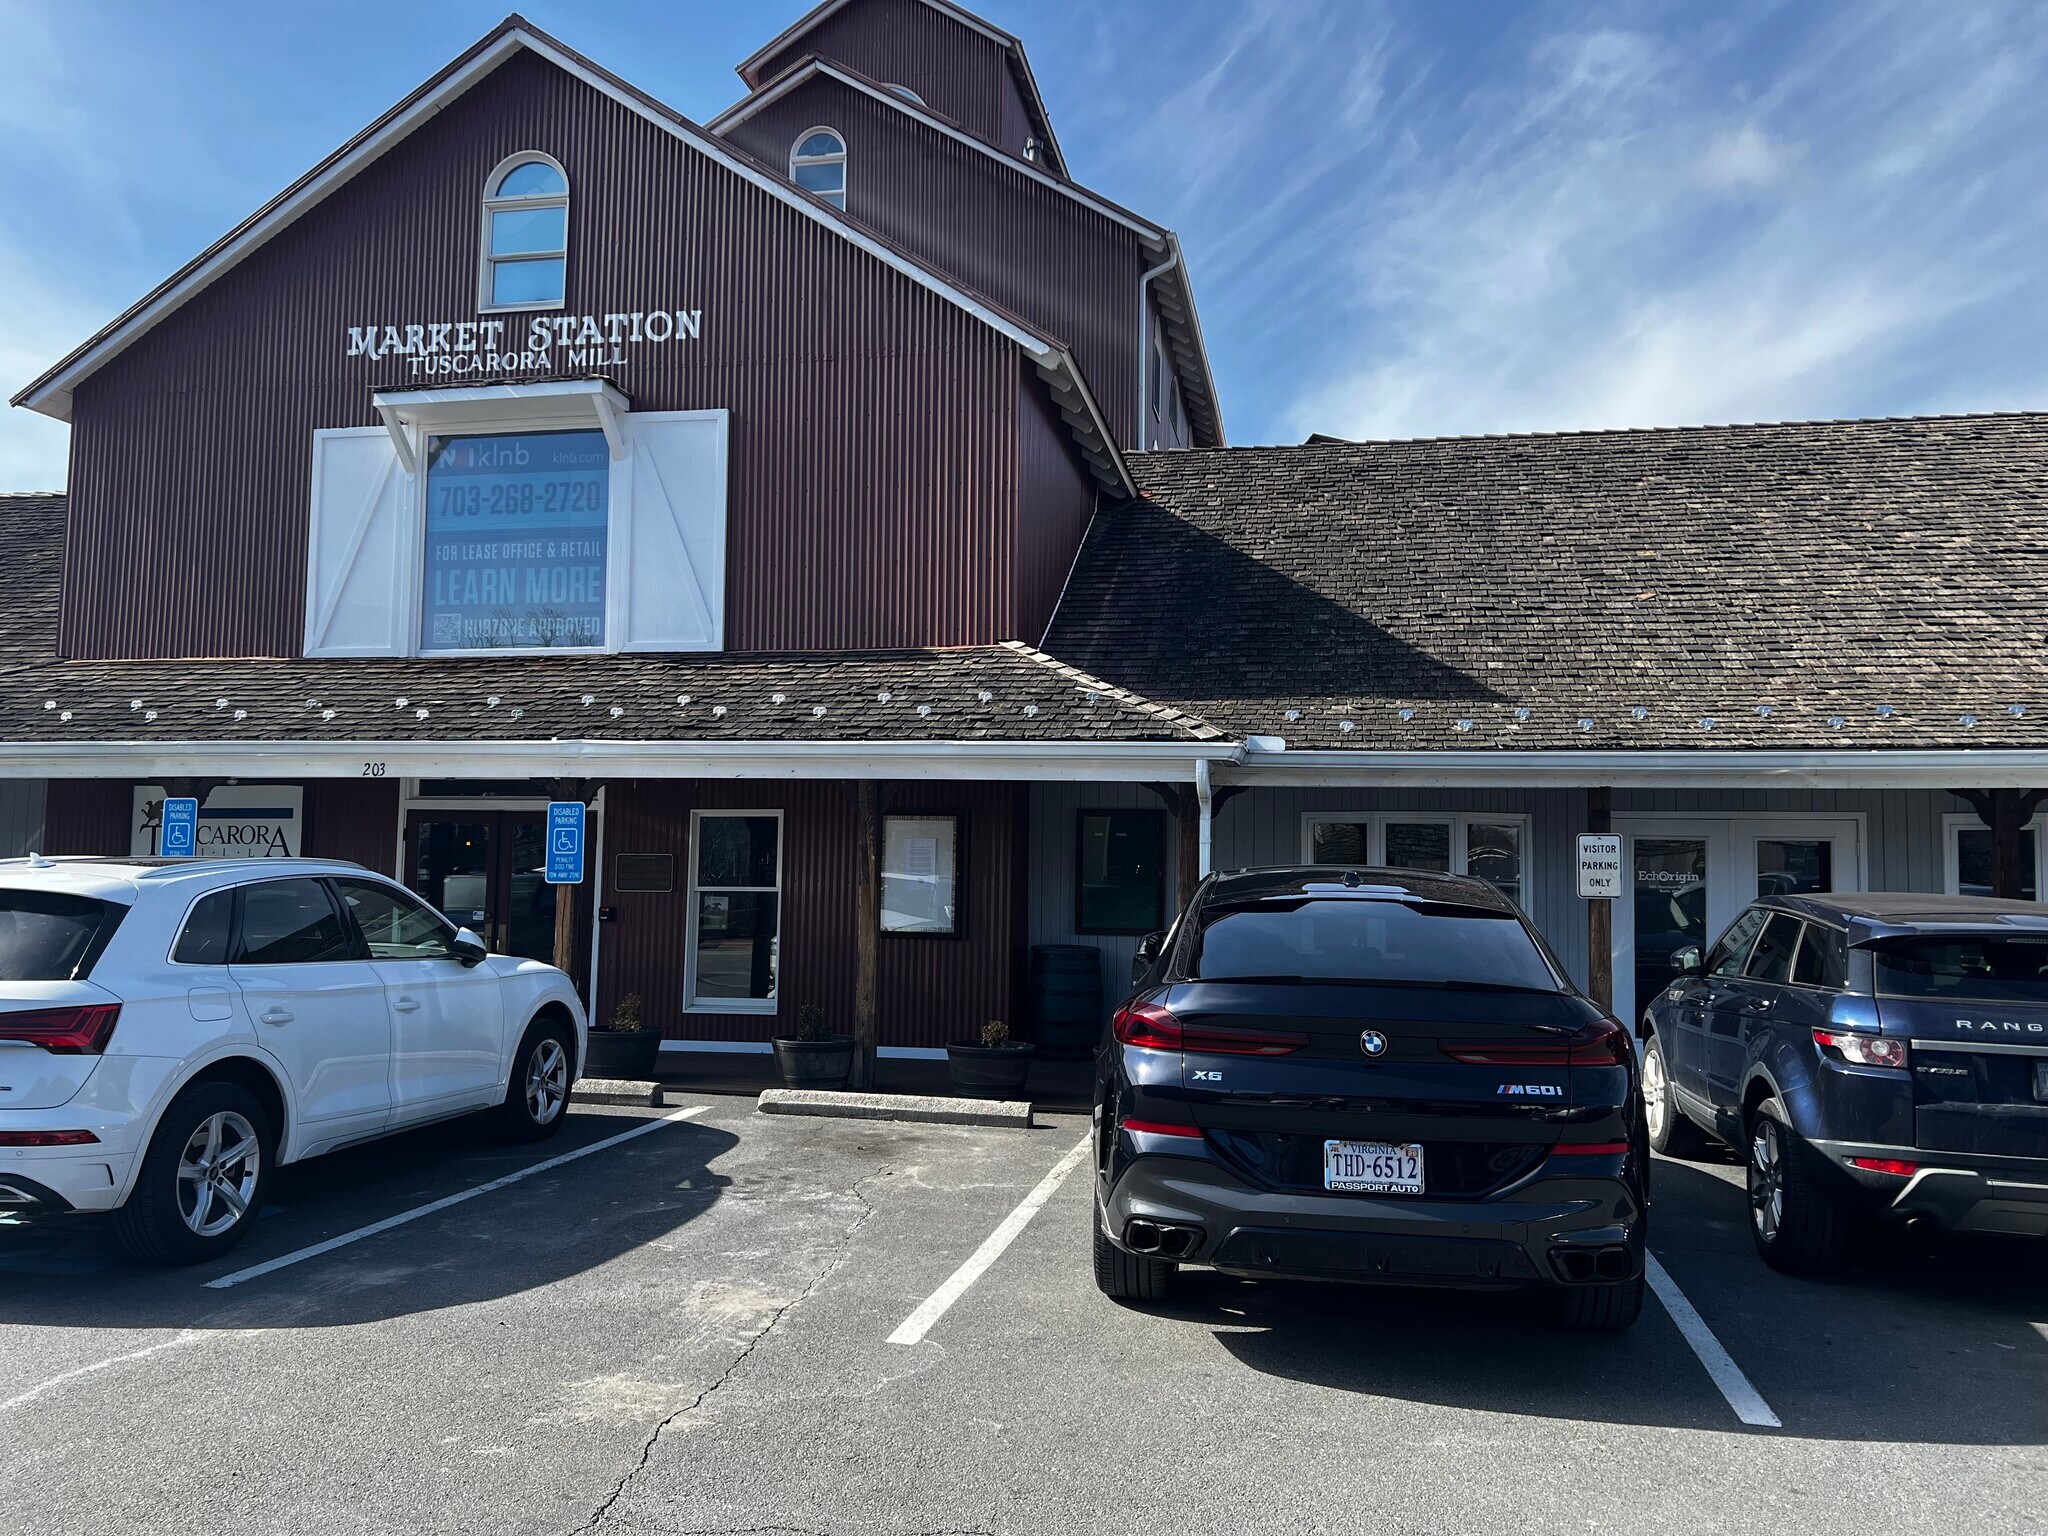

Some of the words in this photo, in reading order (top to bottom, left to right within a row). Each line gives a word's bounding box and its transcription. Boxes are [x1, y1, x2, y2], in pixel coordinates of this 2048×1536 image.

[347, 320, 502, 361] MARKET
[527, 309, 702, 352] STATION
[407, 350, 551, 375] TUSCARORA
[567, 346, 628, 367] MILL
[478, 441, 530, 466] klnb
[553, 452, 604, 464] klnb.com
[439, 481, 601, 517] 703-268-2720
[436, 545, 458, 561] FOR
[462, 544, 498, 560] LEASE
[502, 543, 542, 559] OFFICE
[547, 543, 556, 557] &
[561, 541, 601, 557] RETAIL
[435, 568, 516, 606] LEARN
[525, 566, 601, 604] MORE
[529, 617, 601, 637] APPROVED
[363, 762, 386, 777] 203
[169, 803, 192, 811] DISABLED
[553, 807, 580, 816] DISABLED
[169, 812, 190, 820] PARKING
[555, 816, 577, 825] PARKING
[139, 823, 293, 858] TCARORA
[1583, 844, 1617, 854] VISITOR
[1582, 861, 1618, 871] PARKING
[548, 871, 557, 879] TOW
[557, 871, 568, 879] AWAY
[569, 871, 581, 879] ZONE
[1638, 870, 1700, 884] EchOrigin
[1589, 878, 1611, 887] ONLY
[1956, 1020, 2044, 1032] RANG
[1191, 1070, 1223, 1081] X6
[1350, 1144, 1397, 1155] VIRGINIA
[1332, 1153, 1418, 1179] THD-6512
[1331, 1181, 1389, 1191] PASSPORT
[1390, 1184, 1419, 1193] AUTO
